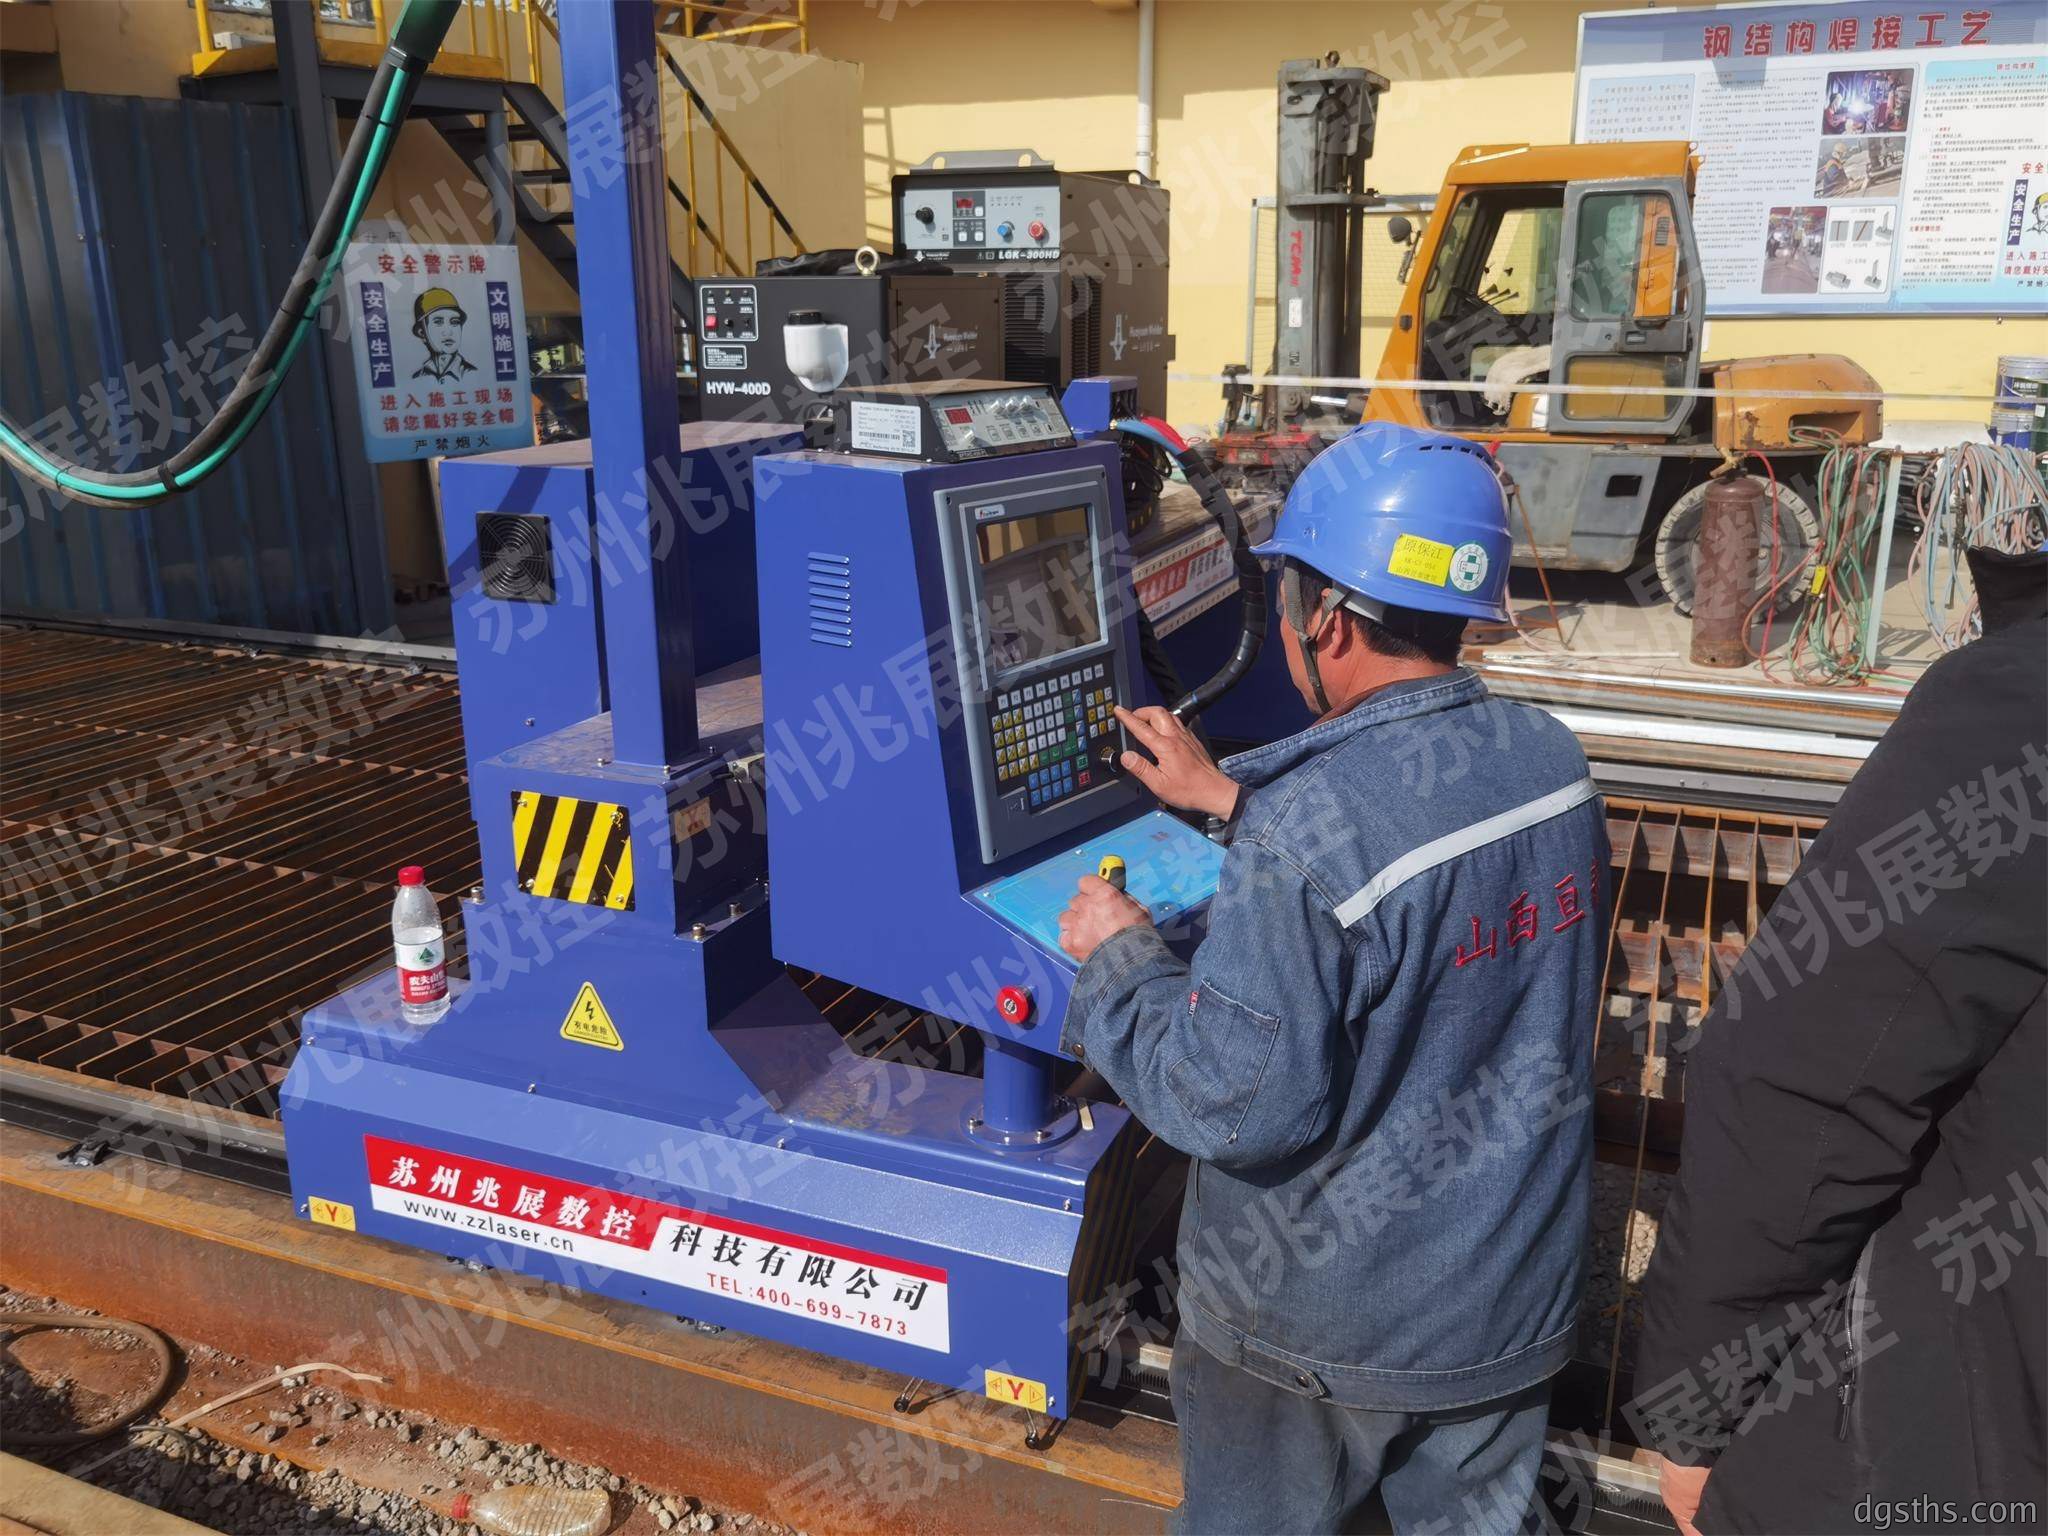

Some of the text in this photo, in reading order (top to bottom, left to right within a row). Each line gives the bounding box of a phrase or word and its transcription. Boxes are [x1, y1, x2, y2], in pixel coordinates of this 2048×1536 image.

[1703, 10, 1994, 58] 钢结构焊接工艺
[2022, 162, 2048, 174] 安全
[2007, 183, 2028, 243] 安全生产
[378, 254, 486, 275] 安全警示牌
[998, 249, 1060, 260] LGK-300HD
[364, 288, 392, 381] 安全生产
[489, 288, 515, 374] 文明施工
[380, 388, 513, 411] 进入施工现场
[706, 382, 771, 395] HYW-400D
[383, 408, 515, 433] 请您戴好安全帽
[415, 434, 491, 453] 严禁烟火
[323, 1204, 339, 1223] Y
[387, 1157, 929, 1311] 苏州兆展数控 科技有限公司
[403, 1197, 575, 1255] www.zzlaser.cn
[706, 1269, 909, 1336] TEL:400-699-7873
[1006, 1378, 1025, 1401] Y
